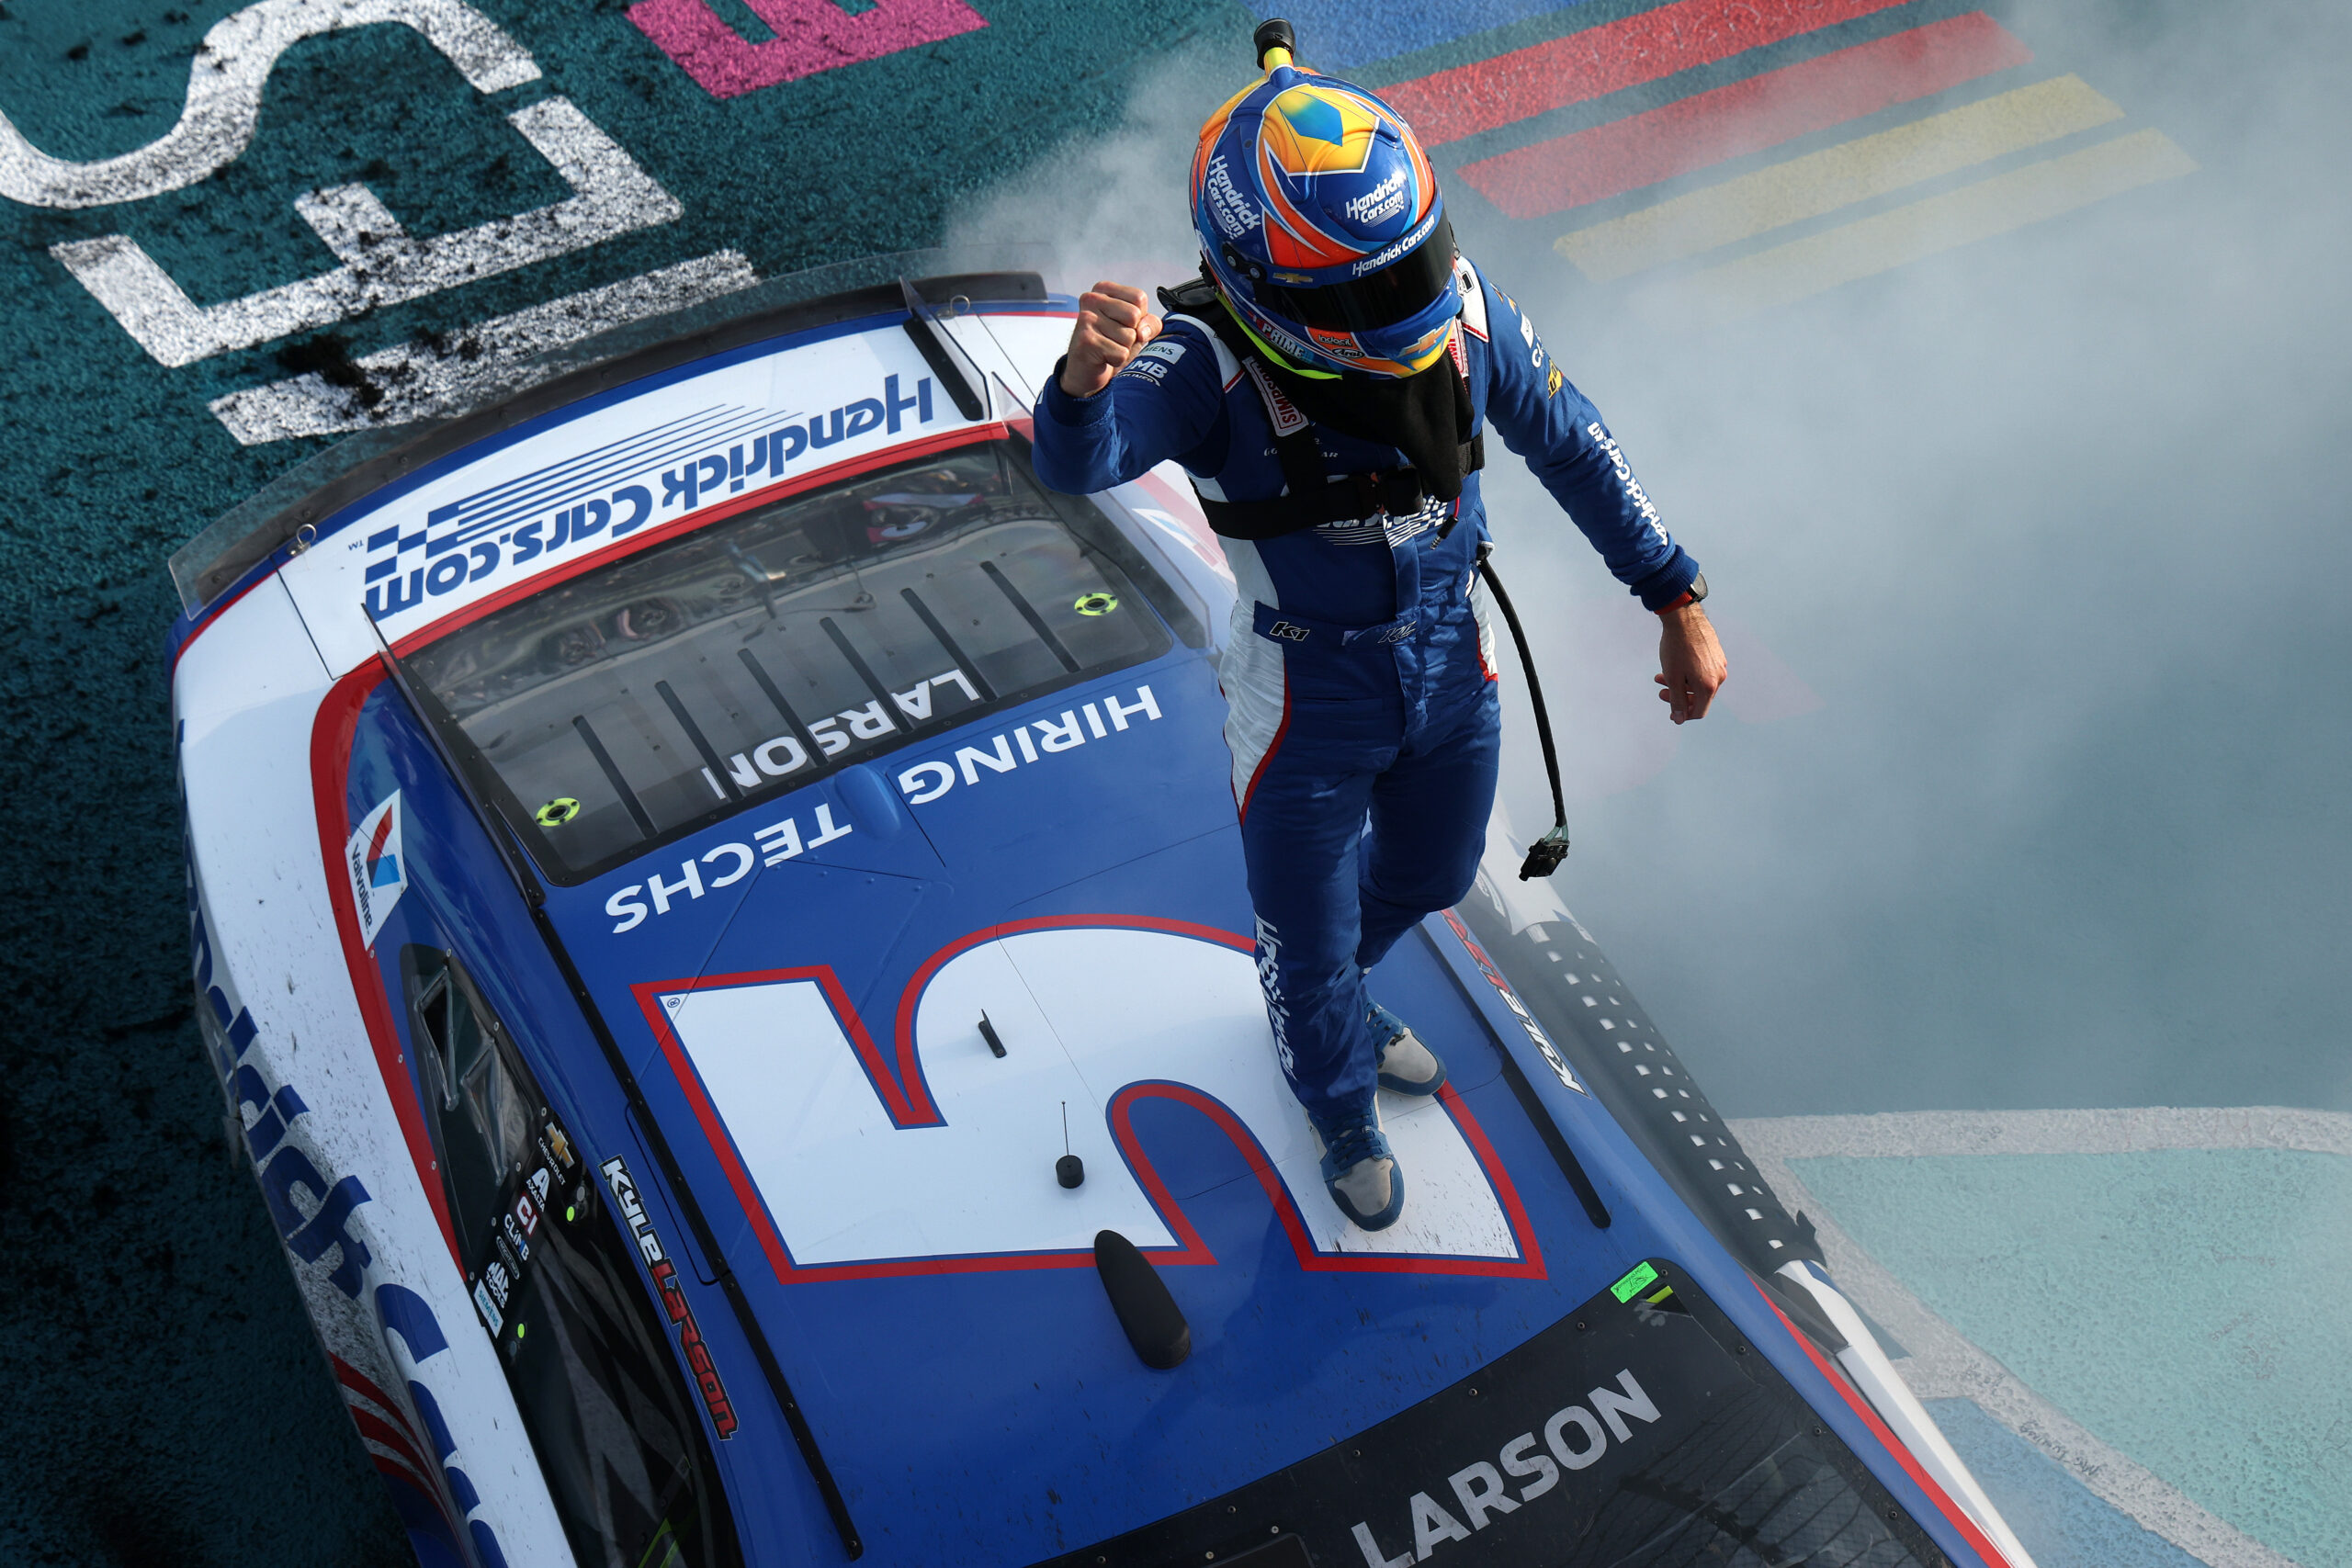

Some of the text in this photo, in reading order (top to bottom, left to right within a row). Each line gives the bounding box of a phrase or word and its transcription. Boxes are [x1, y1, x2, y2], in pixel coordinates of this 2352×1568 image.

[1207, 177, 1246, 236] Cars.com
[1209, 154, 1261, 231] Hendrick
[1345, 169, 1407, 220] Hendrick
[1361, 190, 1404, 223] Cars.com
[1261, 322, 1306, 357] PRIME
[365, 373, 933, 623] HendrickCars.com
[701, 669, 980, 800] LARSON
[899, 684, 1163, 805] HIRING
[352, 842, 373, 929] Valvoline
[605, 803, 853, 934] TECHS
[630, 915, 1547, 1285] 5
[537, 1136, 566, 1186] CHEVROLET
[526, 1179, 546, 1213] AXALTA
[479, 1290, 499, 1327] SIEMENS
[485, 1270, 505, 1309] TOOLS
[487, 1261, 509, 1303] MAC
[1351, 1368, 1662, 1568] LARSON
